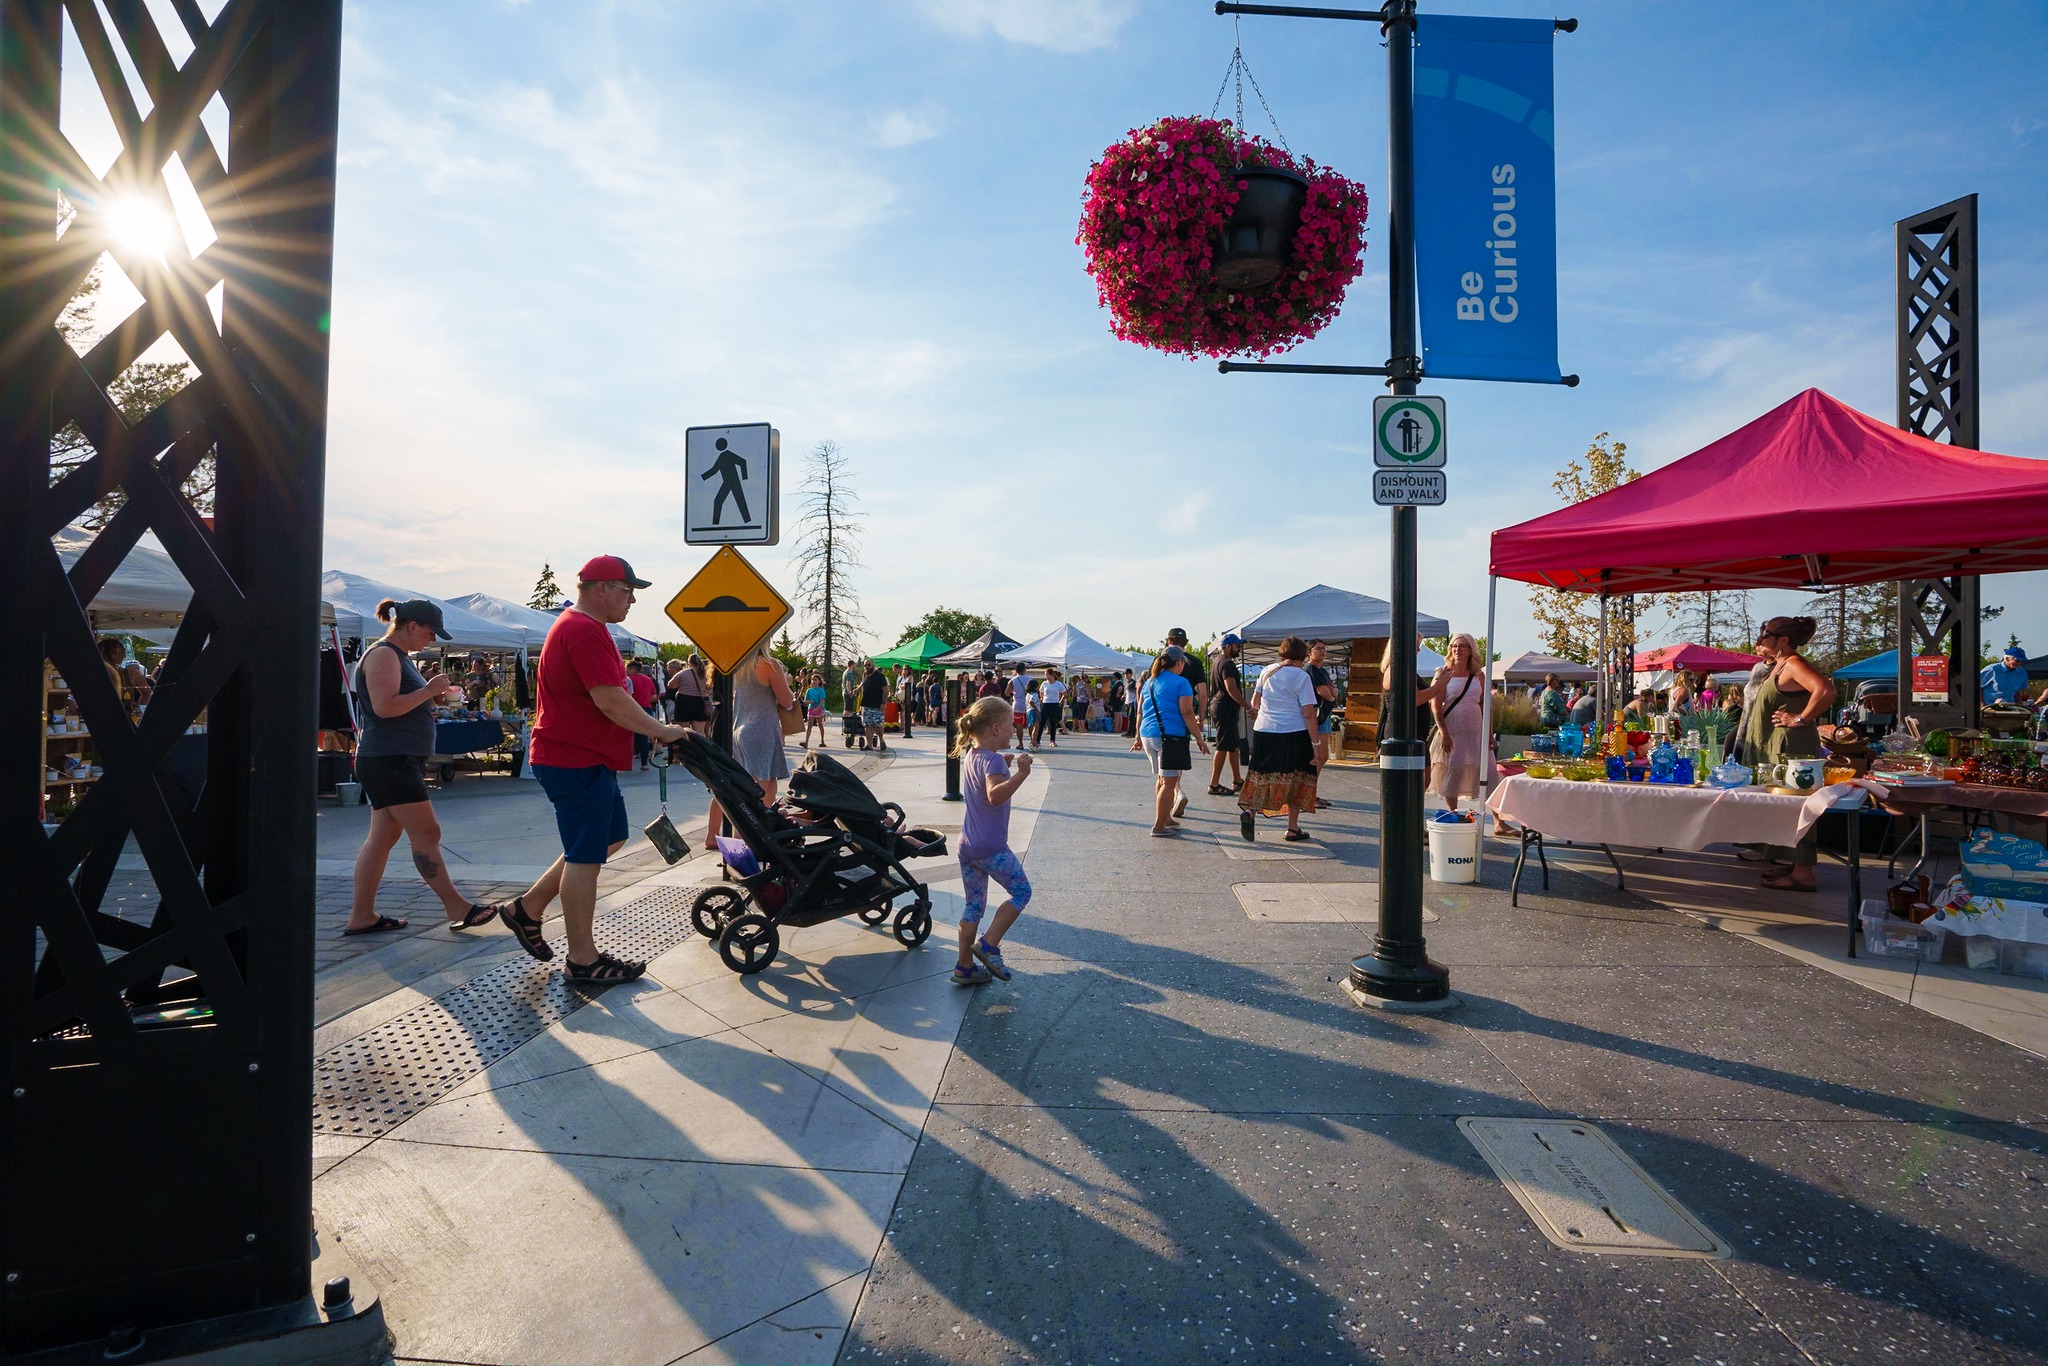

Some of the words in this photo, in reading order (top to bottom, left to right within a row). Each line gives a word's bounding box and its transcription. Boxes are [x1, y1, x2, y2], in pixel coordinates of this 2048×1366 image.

[1485, 163, 1519, 324] Curious
[1457, 271, 1485, 321] Be
[1380, 476, 1439, 487] DISMOUNT
[1380, 488, 1404, 499] AND
[1408, 488, 1440, 499] WALK
[1447, 856, 1474, 865] RONA
